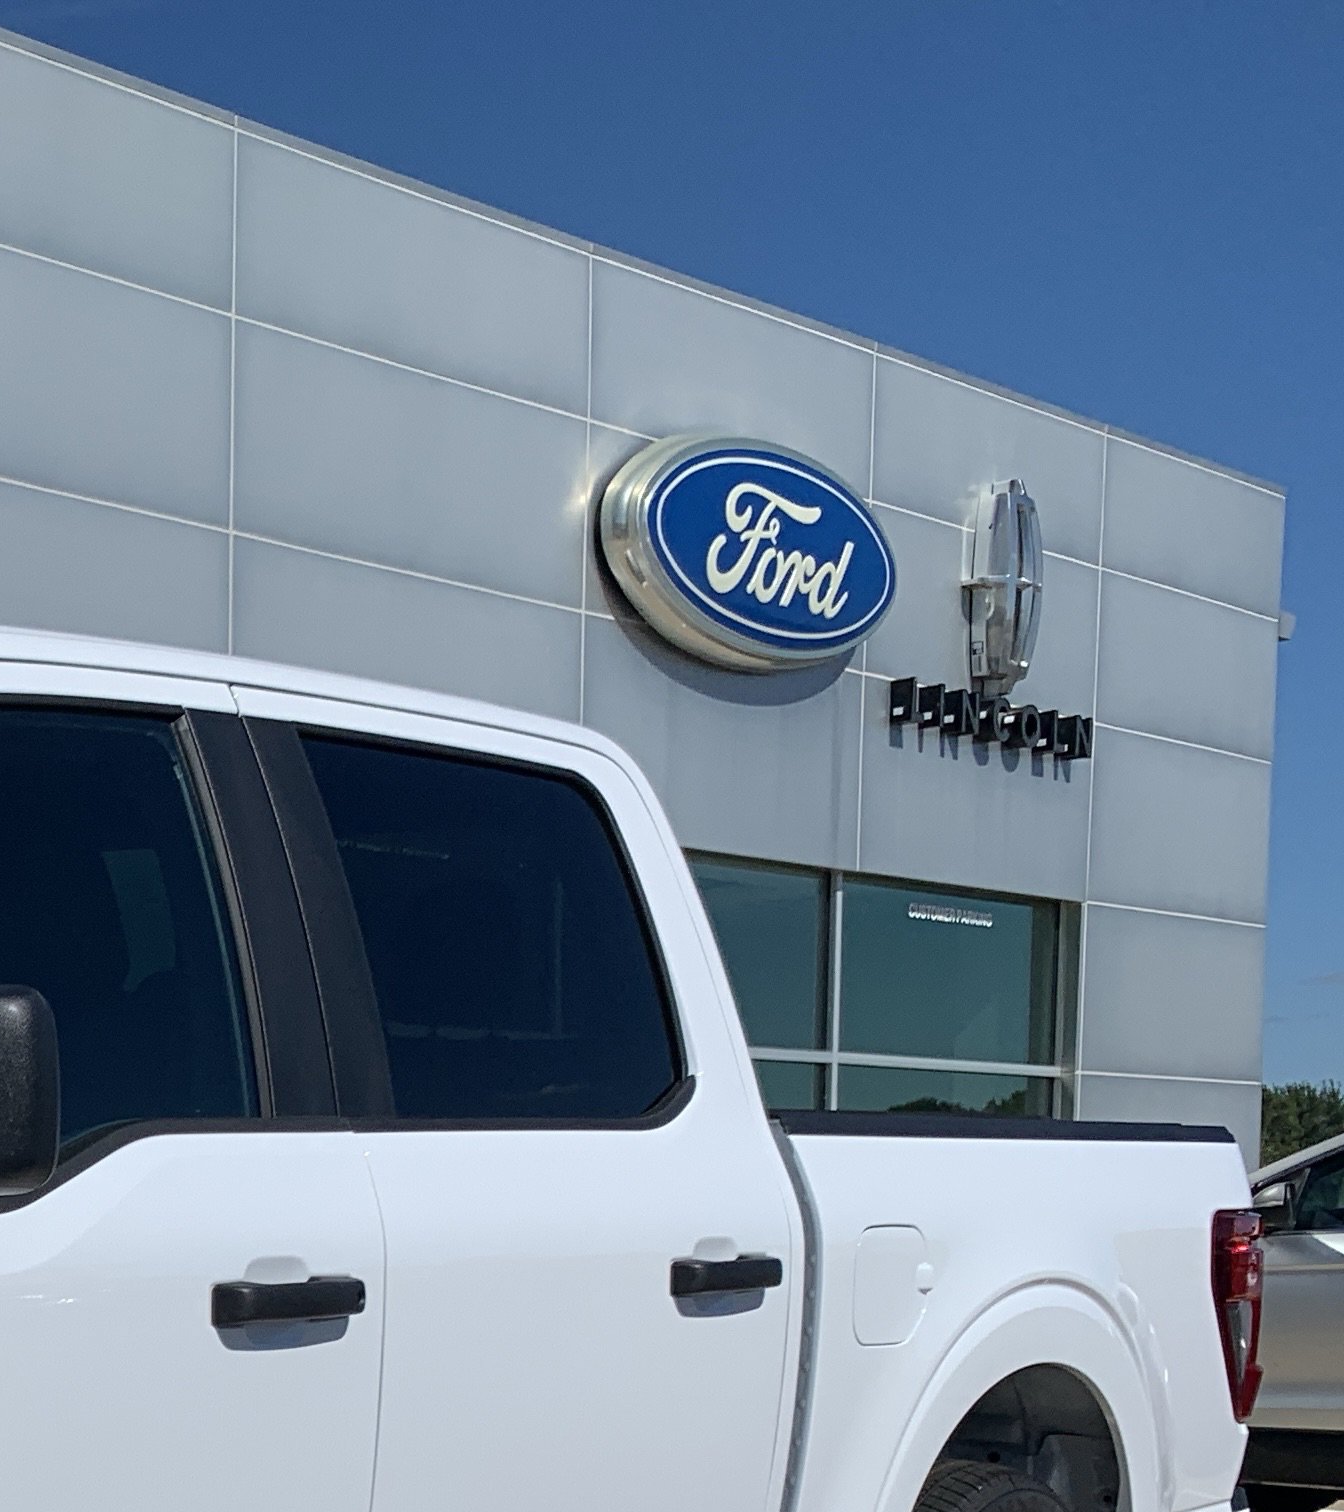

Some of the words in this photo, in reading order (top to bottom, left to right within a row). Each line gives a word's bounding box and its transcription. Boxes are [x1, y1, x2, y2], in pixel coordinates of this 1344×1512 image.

[706, 482, 856, 619] Ford
[891, 677, 1092, 758] LINCOLN
[908, 902, 955, 923] CUSTOMER
[956, 908, 993, 928] PARKING
